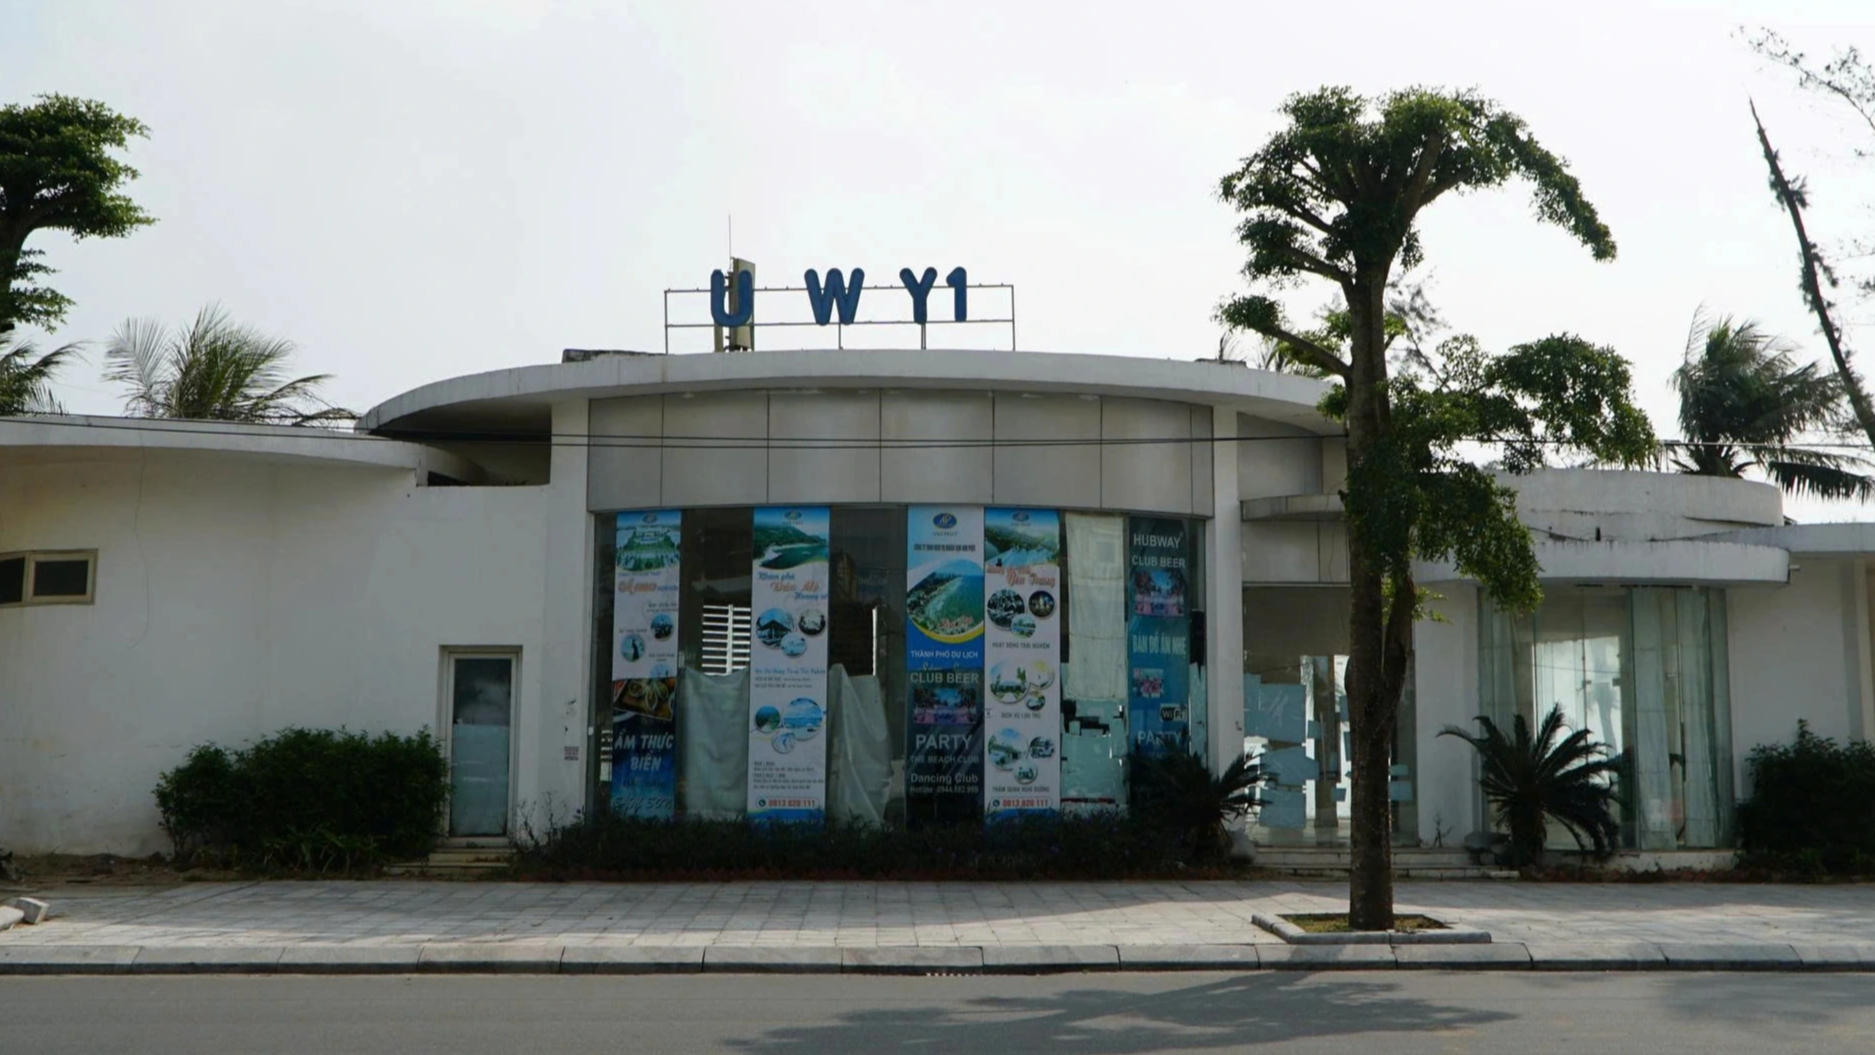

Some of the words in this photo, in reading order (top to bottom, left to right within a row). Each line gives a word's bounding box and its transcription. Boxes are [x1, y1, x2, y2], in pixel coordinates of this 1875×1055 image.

[711, 269, 752, 326] U
[804, 268, 865, 326] W
[1133, 533, 1181, 549] HUBWAY
[1131, 555, 1157, 567] CLUB
[1159, 556, 1186, 569] BEER
[951, 651, 962, 659] DU
[910, 672, 943, 684] CLUB
[946, 672, 979, 684] BEER
[916, 734, 972, 750] PARTY
[928, 755, 955, 764] BEACH
[957, 755, 979, 764] CLUB
[911, 772, 952, 785] Dancing
[954, 772, 979, 783] Club
